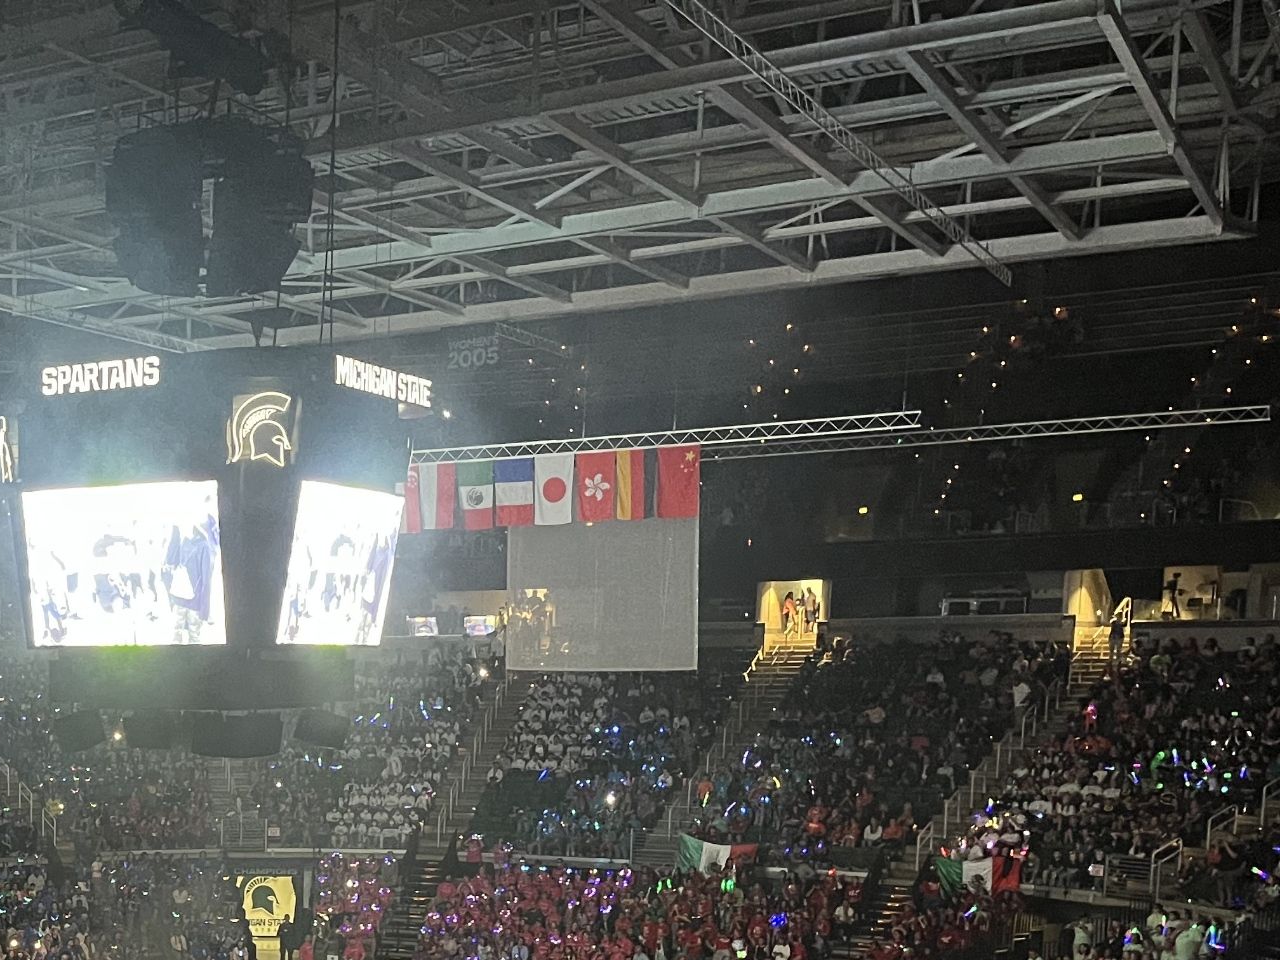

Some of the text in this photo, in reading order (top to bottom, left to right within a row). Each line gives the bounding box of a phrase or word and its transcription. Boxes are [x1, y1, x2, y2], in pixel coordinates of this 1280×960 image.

[42, 355, 161, 396] SPARTANS
[447, 347, 500, 370] 2005
[335, 354, 433, 409] MICHIGAN STATE
